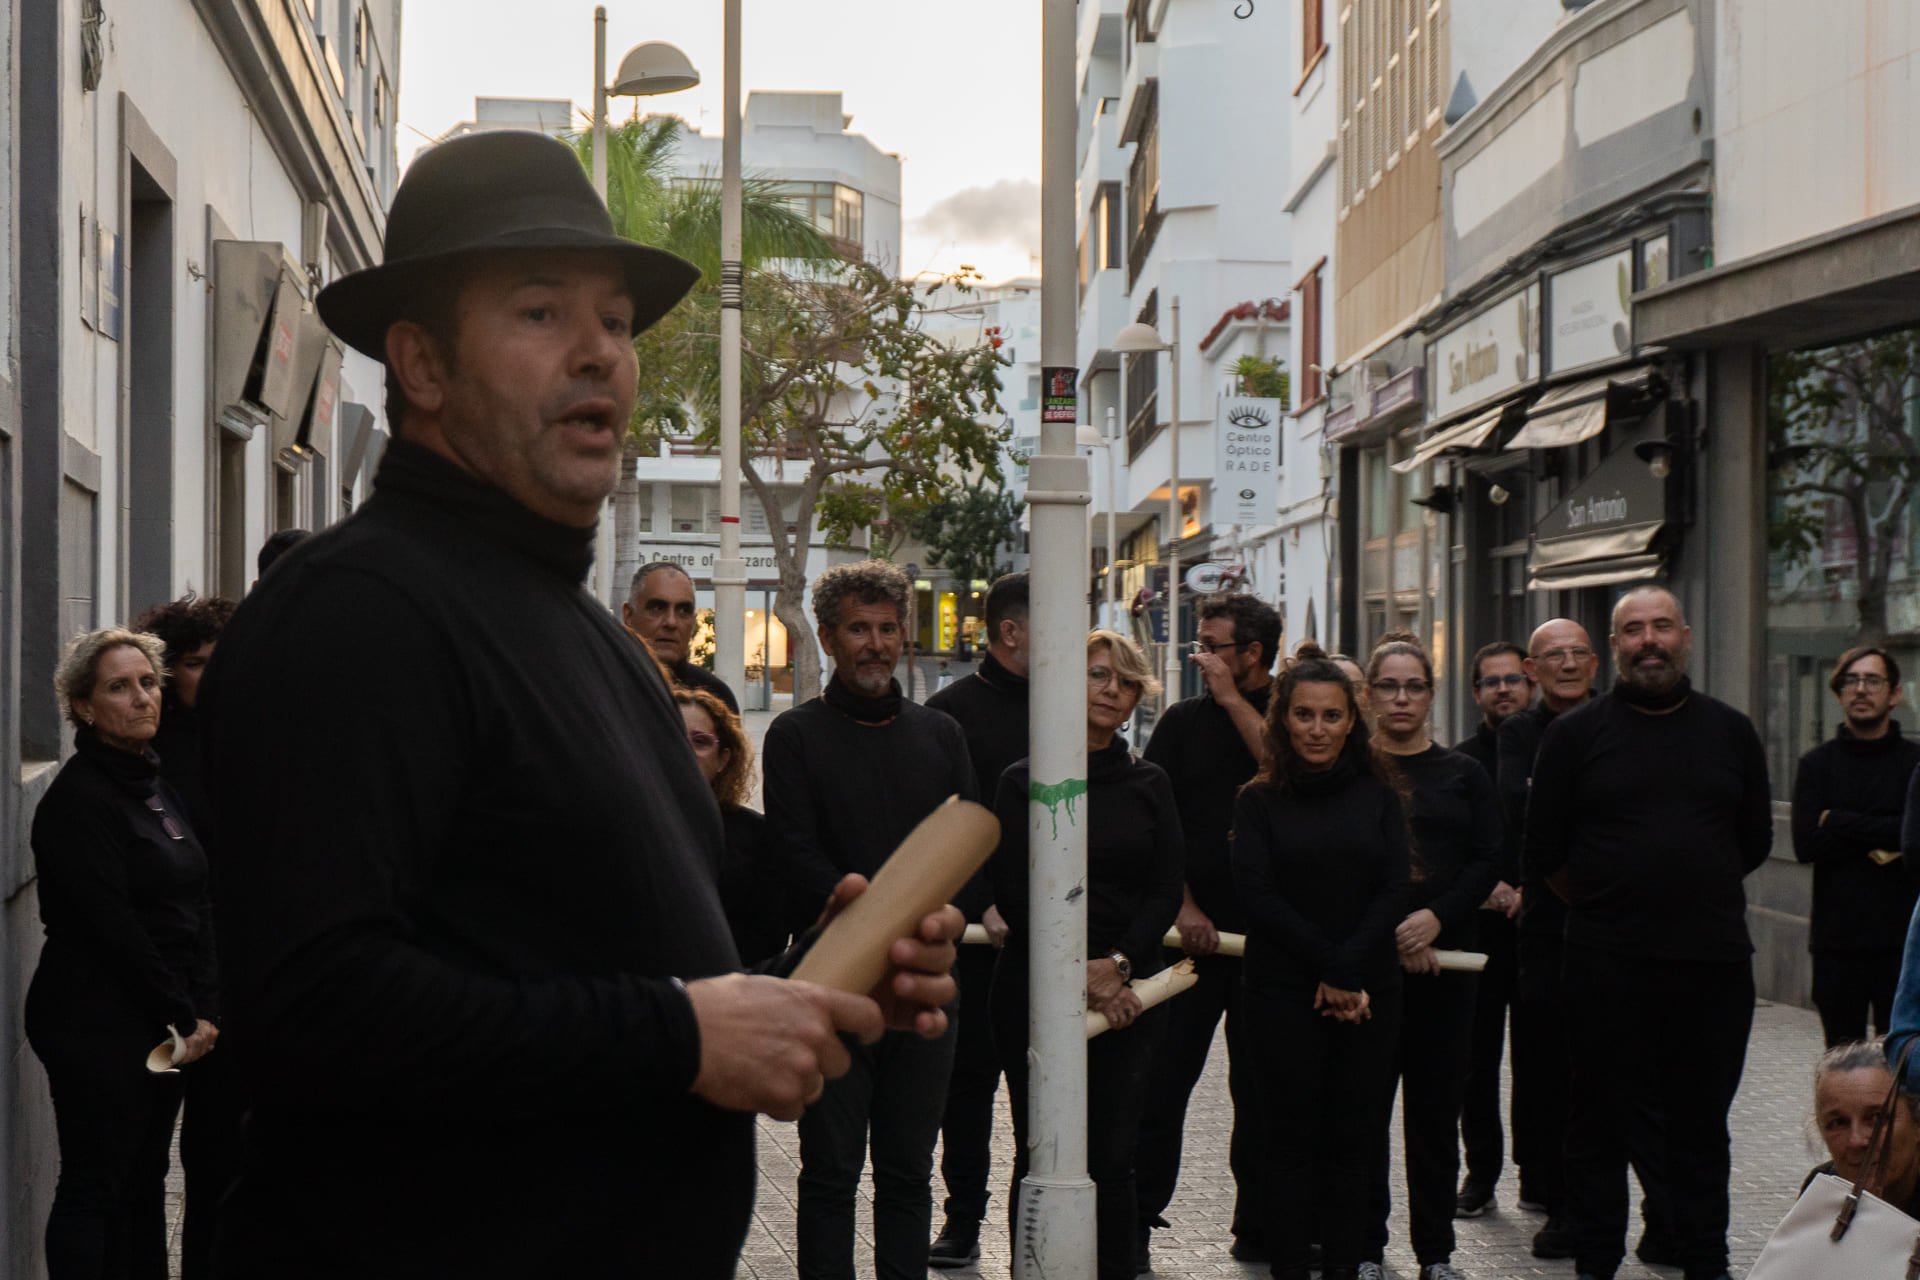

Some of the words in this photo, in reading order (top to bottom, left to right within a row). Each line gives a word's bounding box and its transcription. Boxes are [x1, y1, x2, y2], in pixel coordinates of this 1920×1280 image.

[1226, 431, 1272, 443] Centro
[1225, 460, 1272, 472] RADE
[1567, 499, 1585, 528] San
[1587, 489, 1627, 523] Antonio
[701, 552, 715, 567] of
